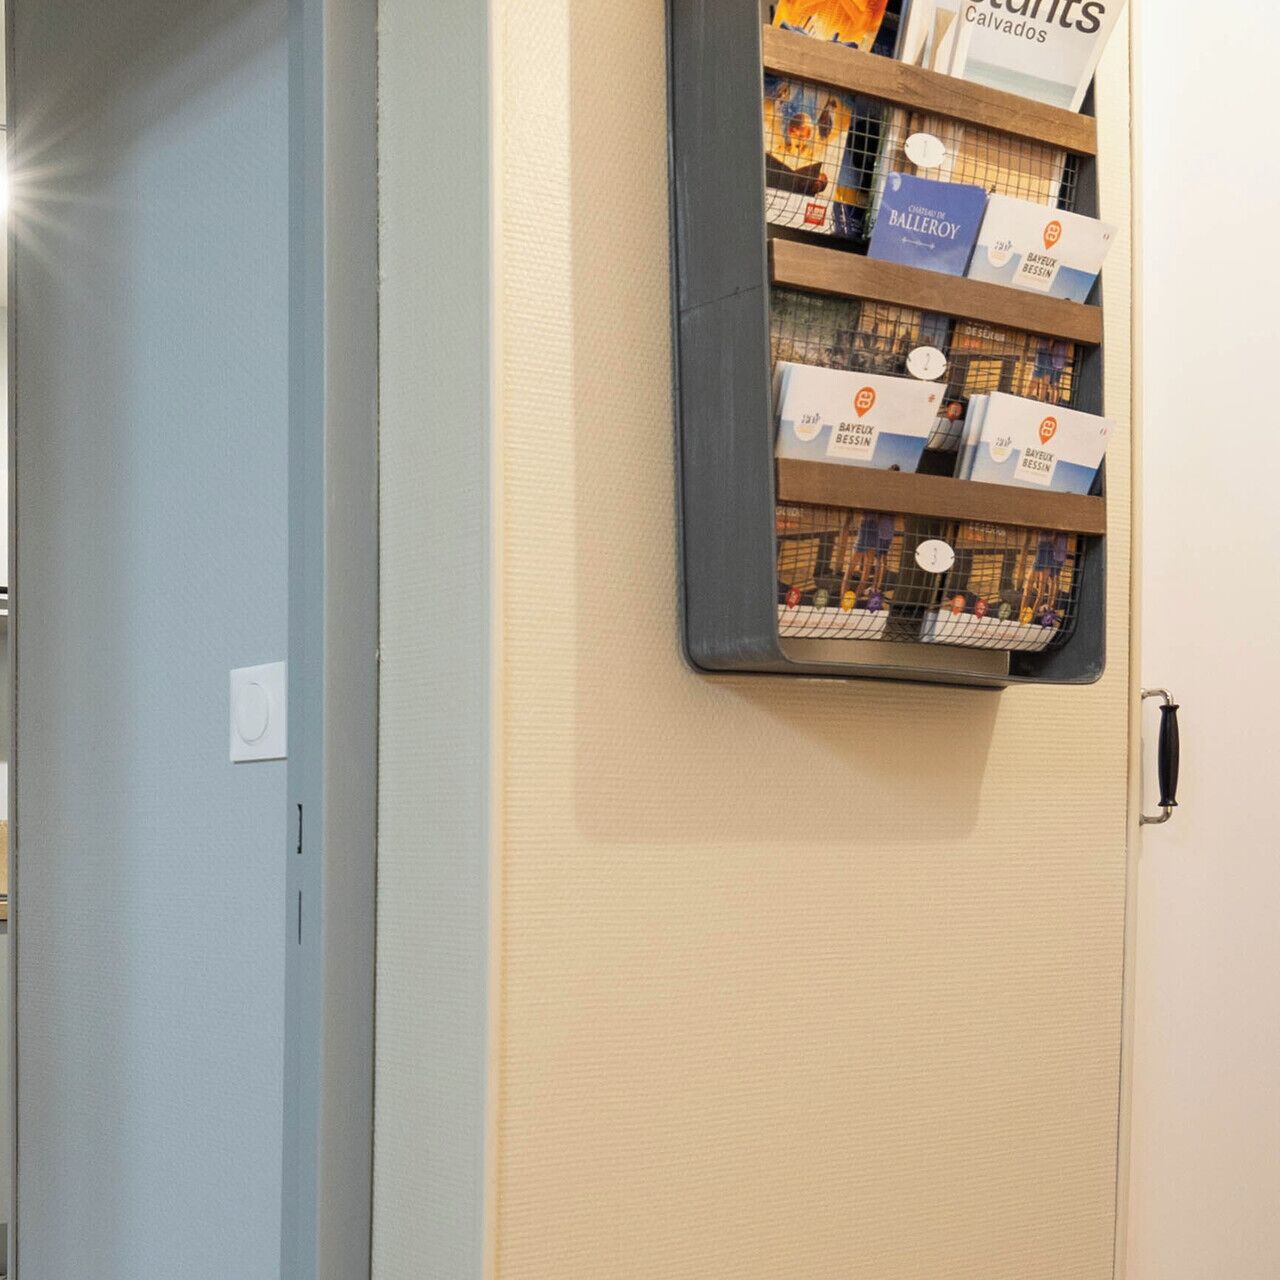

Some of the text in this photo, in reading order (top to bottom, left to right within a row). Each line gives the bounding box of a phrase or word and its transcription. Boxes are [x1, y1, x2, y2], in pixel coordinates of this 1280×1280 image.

[965, 5, 1047, 43] Calvados
[888, 209, 961, 240] BALLEROY
[1026, 252, 1058, 268] BAYEUX
[1022, 263, 1053, 279] BESSIN
[838, 422, 874, 436] BAYEUX
[835, 434, 872, 447] BESSIN
[1025, 448, 1055, 463] BAYEUX
[1022, 460, 1051, 473] BESSIN
